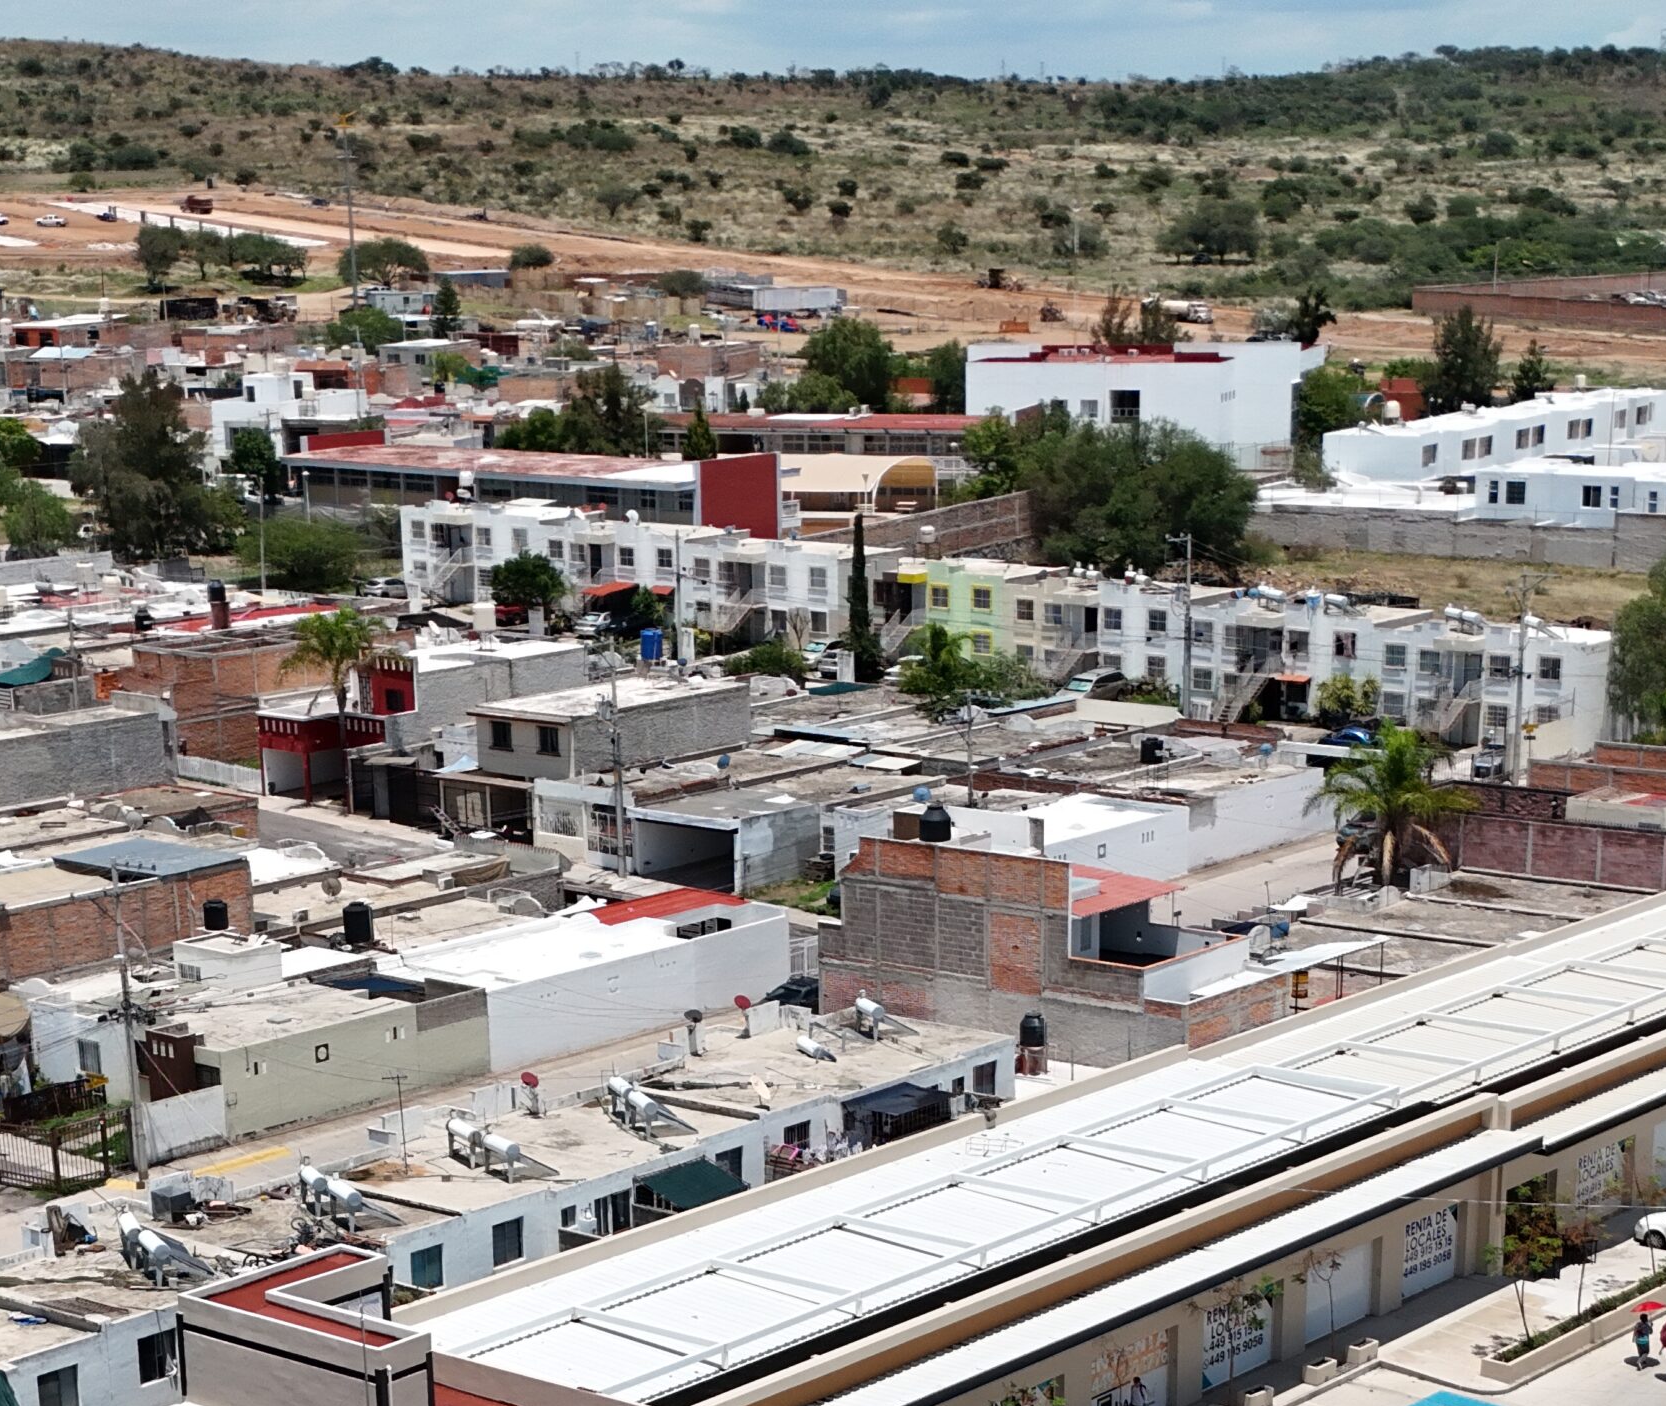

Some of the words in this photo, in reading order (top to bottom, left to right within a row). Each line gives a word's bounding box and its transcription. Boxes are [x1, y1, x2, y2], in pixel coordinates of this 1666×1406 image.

[1406, 1216, 1432, 1238] RENTA
[1435, 1209, 1448, 1225] DE
[1406, 1224, 1446, 1253] LOCALES
[1445, 1235, 1453, 1247] 15
[1209, 1336, 1225, 1351] 449
[1209, 1351, 1225, 1366] 449
